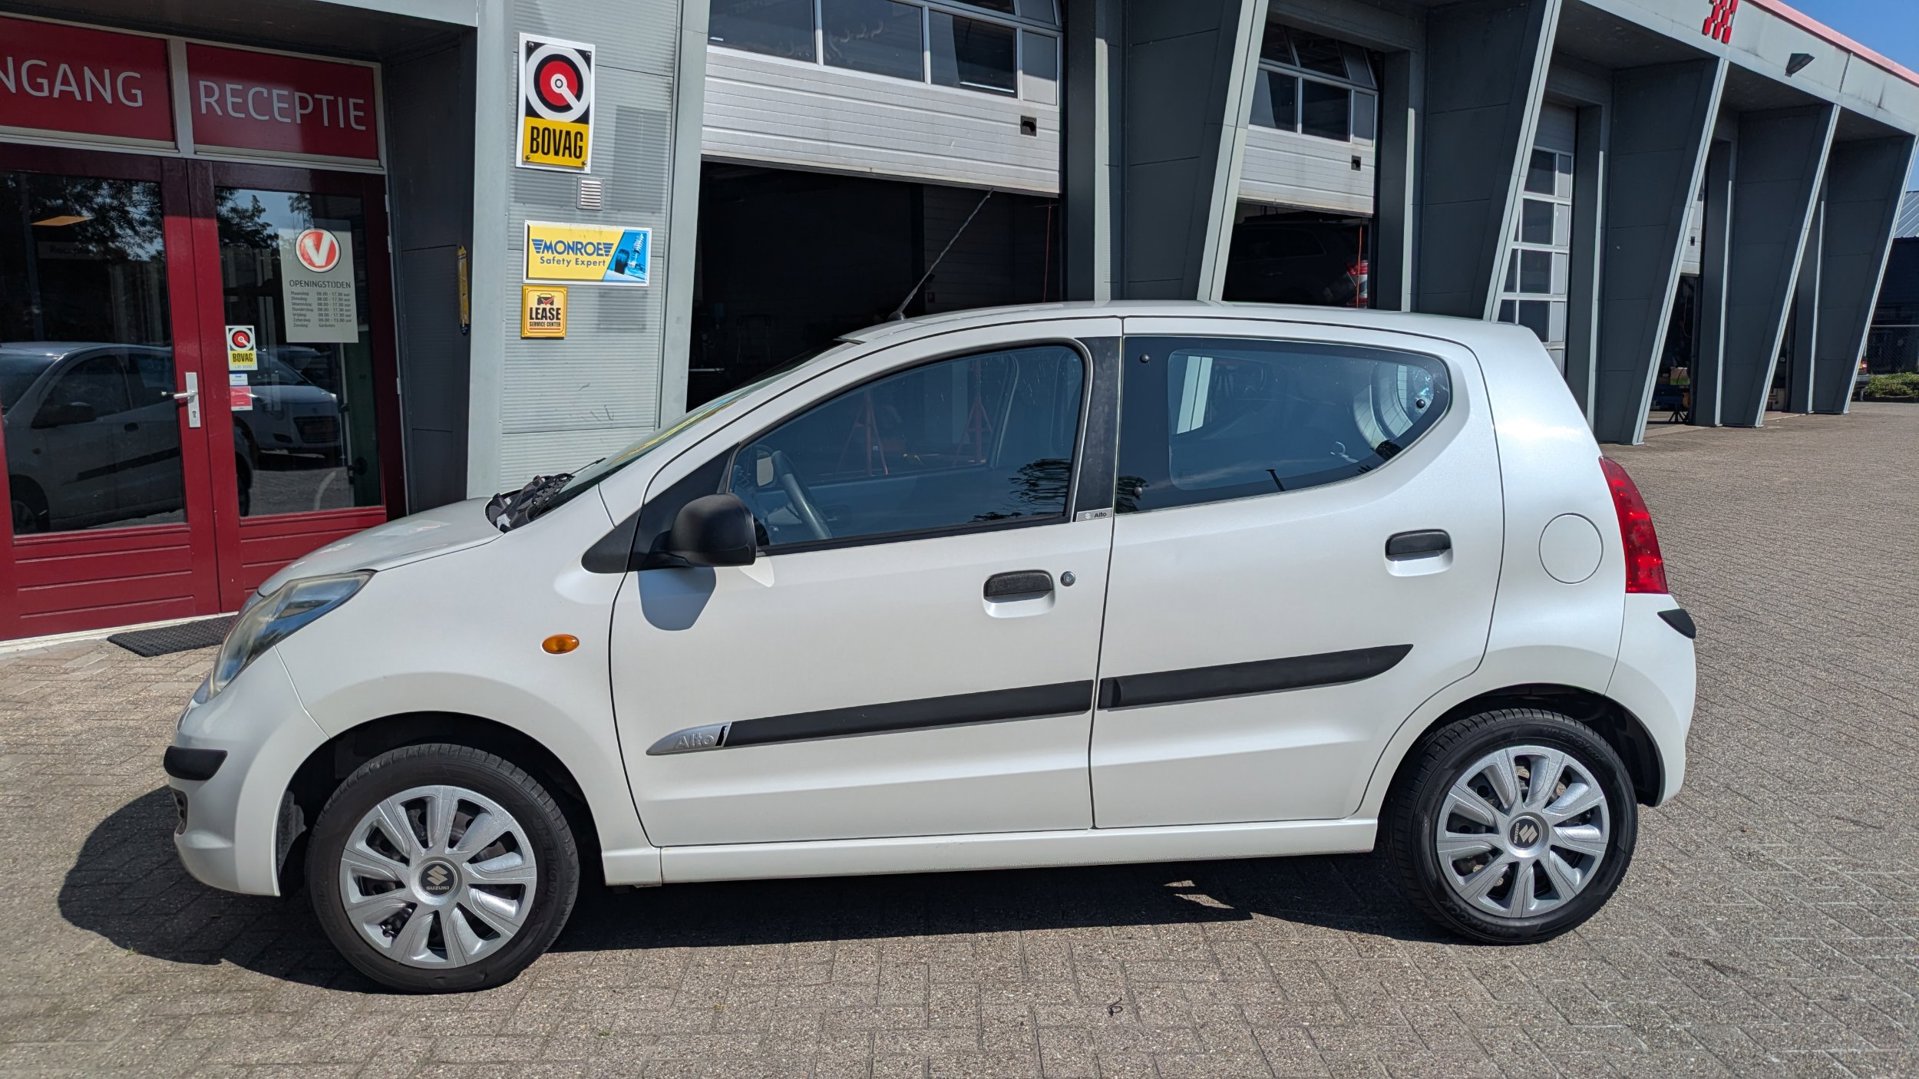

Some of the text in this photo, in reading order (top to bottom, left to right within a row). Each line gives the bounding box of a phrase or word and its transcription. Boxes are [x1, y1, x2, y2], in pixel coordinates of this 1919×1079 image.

[0, 56, 143, 108] NGANG
[199, 80, 366, 131] RECEPTIE
[530, 126, 584, 159] BOVAG
[541, 239, 606, 257] MONROE
[540, 256, 606, 268] Safety Expert
[289, 280, 352, 289] OPENINGSTIJDEN
[529, 307, 561, 321] LEASE
[232, 353, 253, 362] BOVAG
[676, 732, 715, 748] Alto
